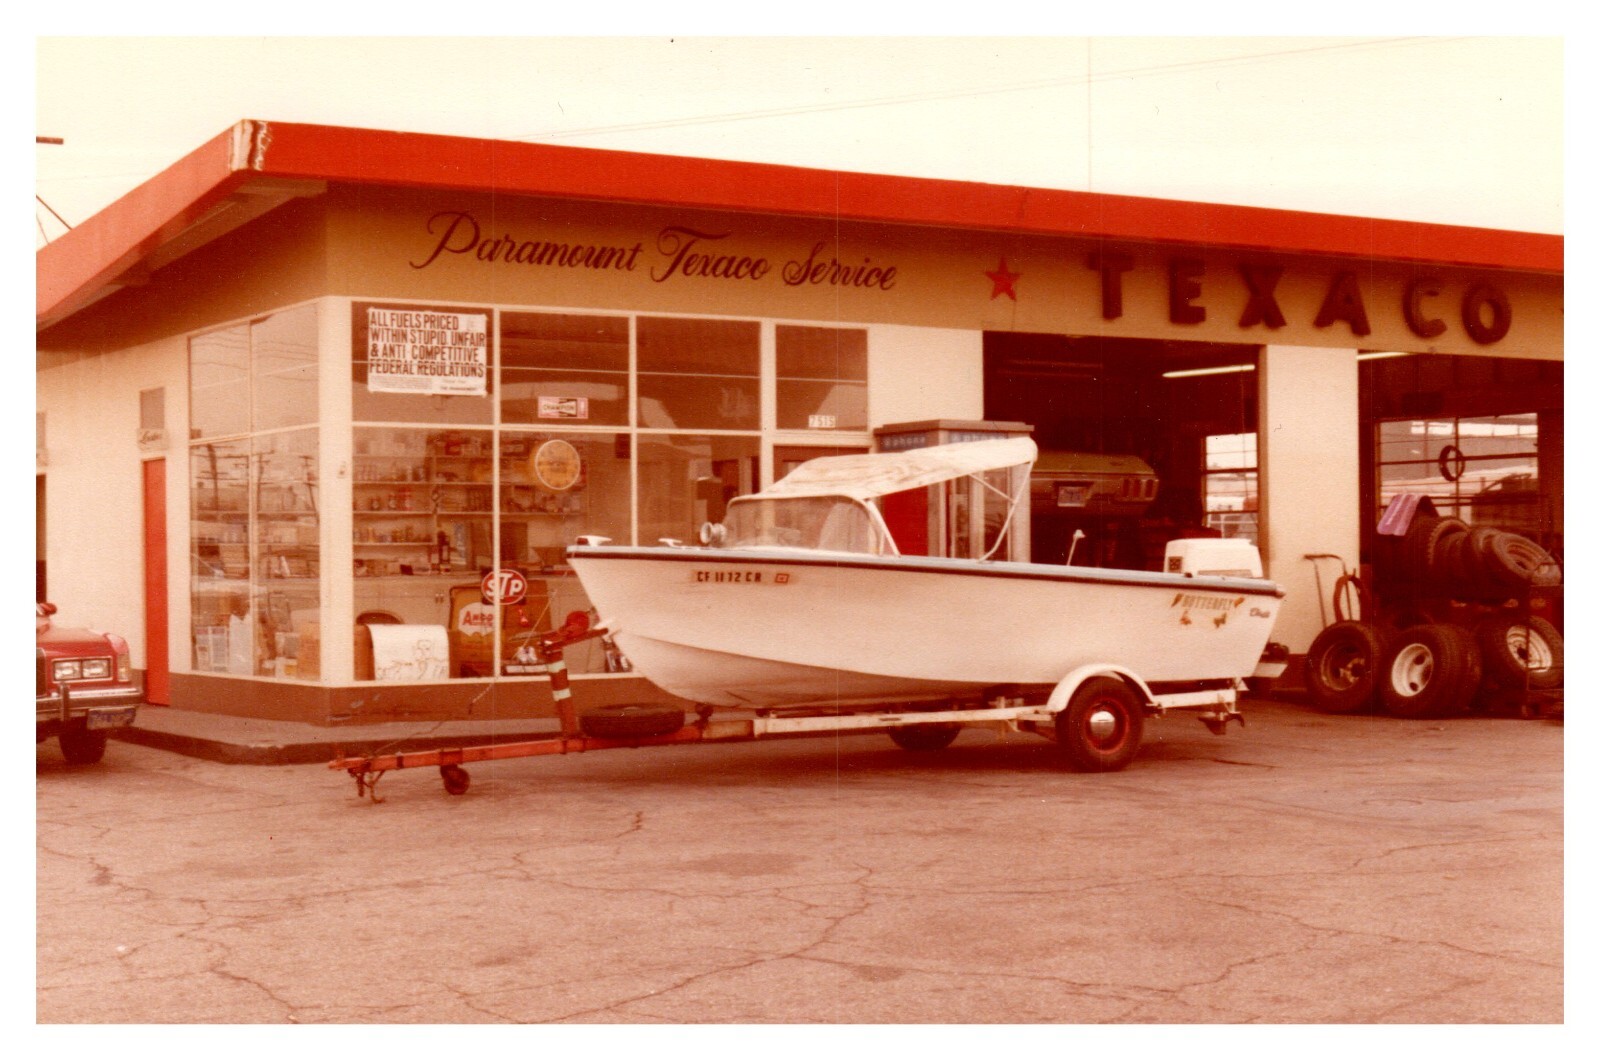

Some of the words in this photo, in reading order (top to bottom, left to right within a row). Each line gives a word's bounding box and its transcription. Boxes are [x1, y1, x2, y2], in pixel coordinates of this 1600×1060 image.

[409, 211, 644, 272] Paramount
[650, 225, 772, 283] Texaco
[781, 239, 897, 291] Service
[1087, 251, 1512, 345] TEXACO
[370, 311, 389, 327] ALL
[390, 312, 421, 329] FUELS
[423, 314, 459, 331] PRICED
[370, 327, 408, 343] WITHIN
[450, 331, 486, 347] UNFAIR
[370, 343, 379, 358] &
[369, 358, 415, 375] FEDERAL
[417, 360, 484, 378] REGULATIONS
[485, 572, 524, 600] STP
[697, 571, 710, 582] CF
[1182, 595, 1234, 611] BUTTERFLY
